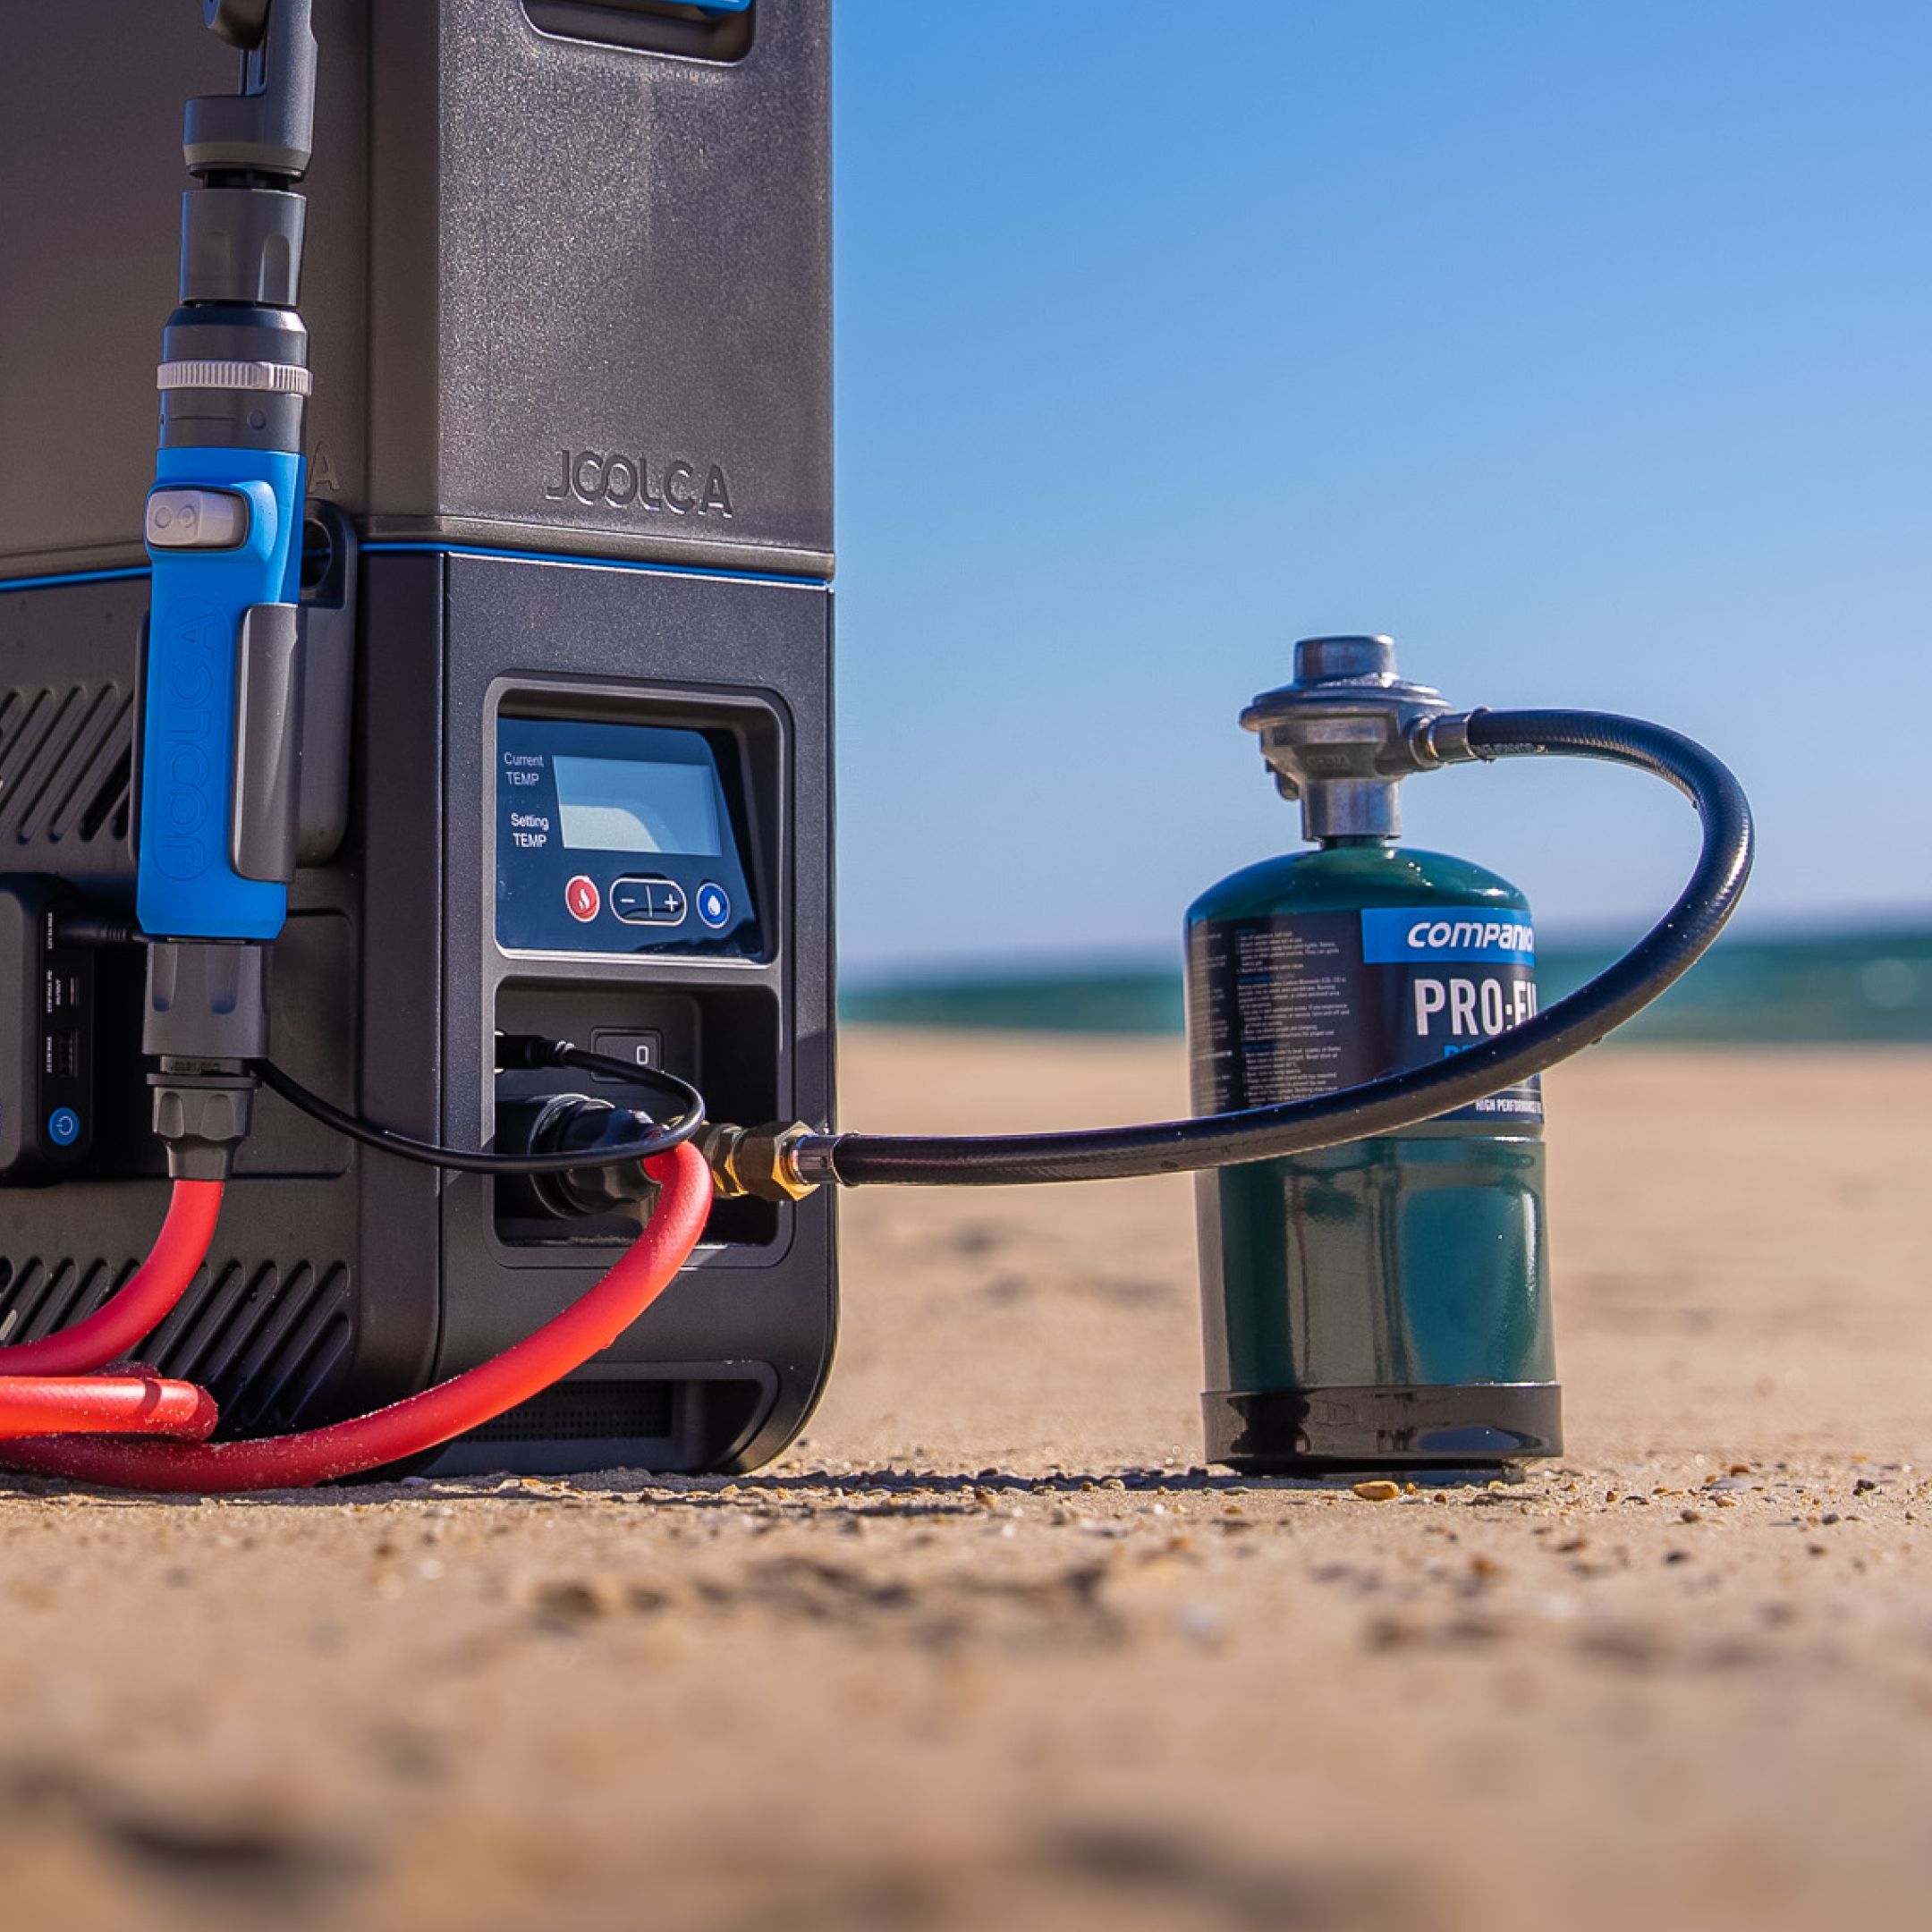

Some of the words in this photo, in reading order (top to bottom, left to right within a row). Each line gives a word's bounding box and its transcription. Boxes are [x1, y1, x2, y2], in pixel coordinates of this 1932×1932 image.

[545, 449, 733, 519] JOOLCA
[161, 611, 216, 869] JOOLCA
[503, 751, 545, 767] Current
[505, 771, 540, 786] TEMP
[510, 813, 550, 831] Setting
[513, 833, 547, 849] TEMP
